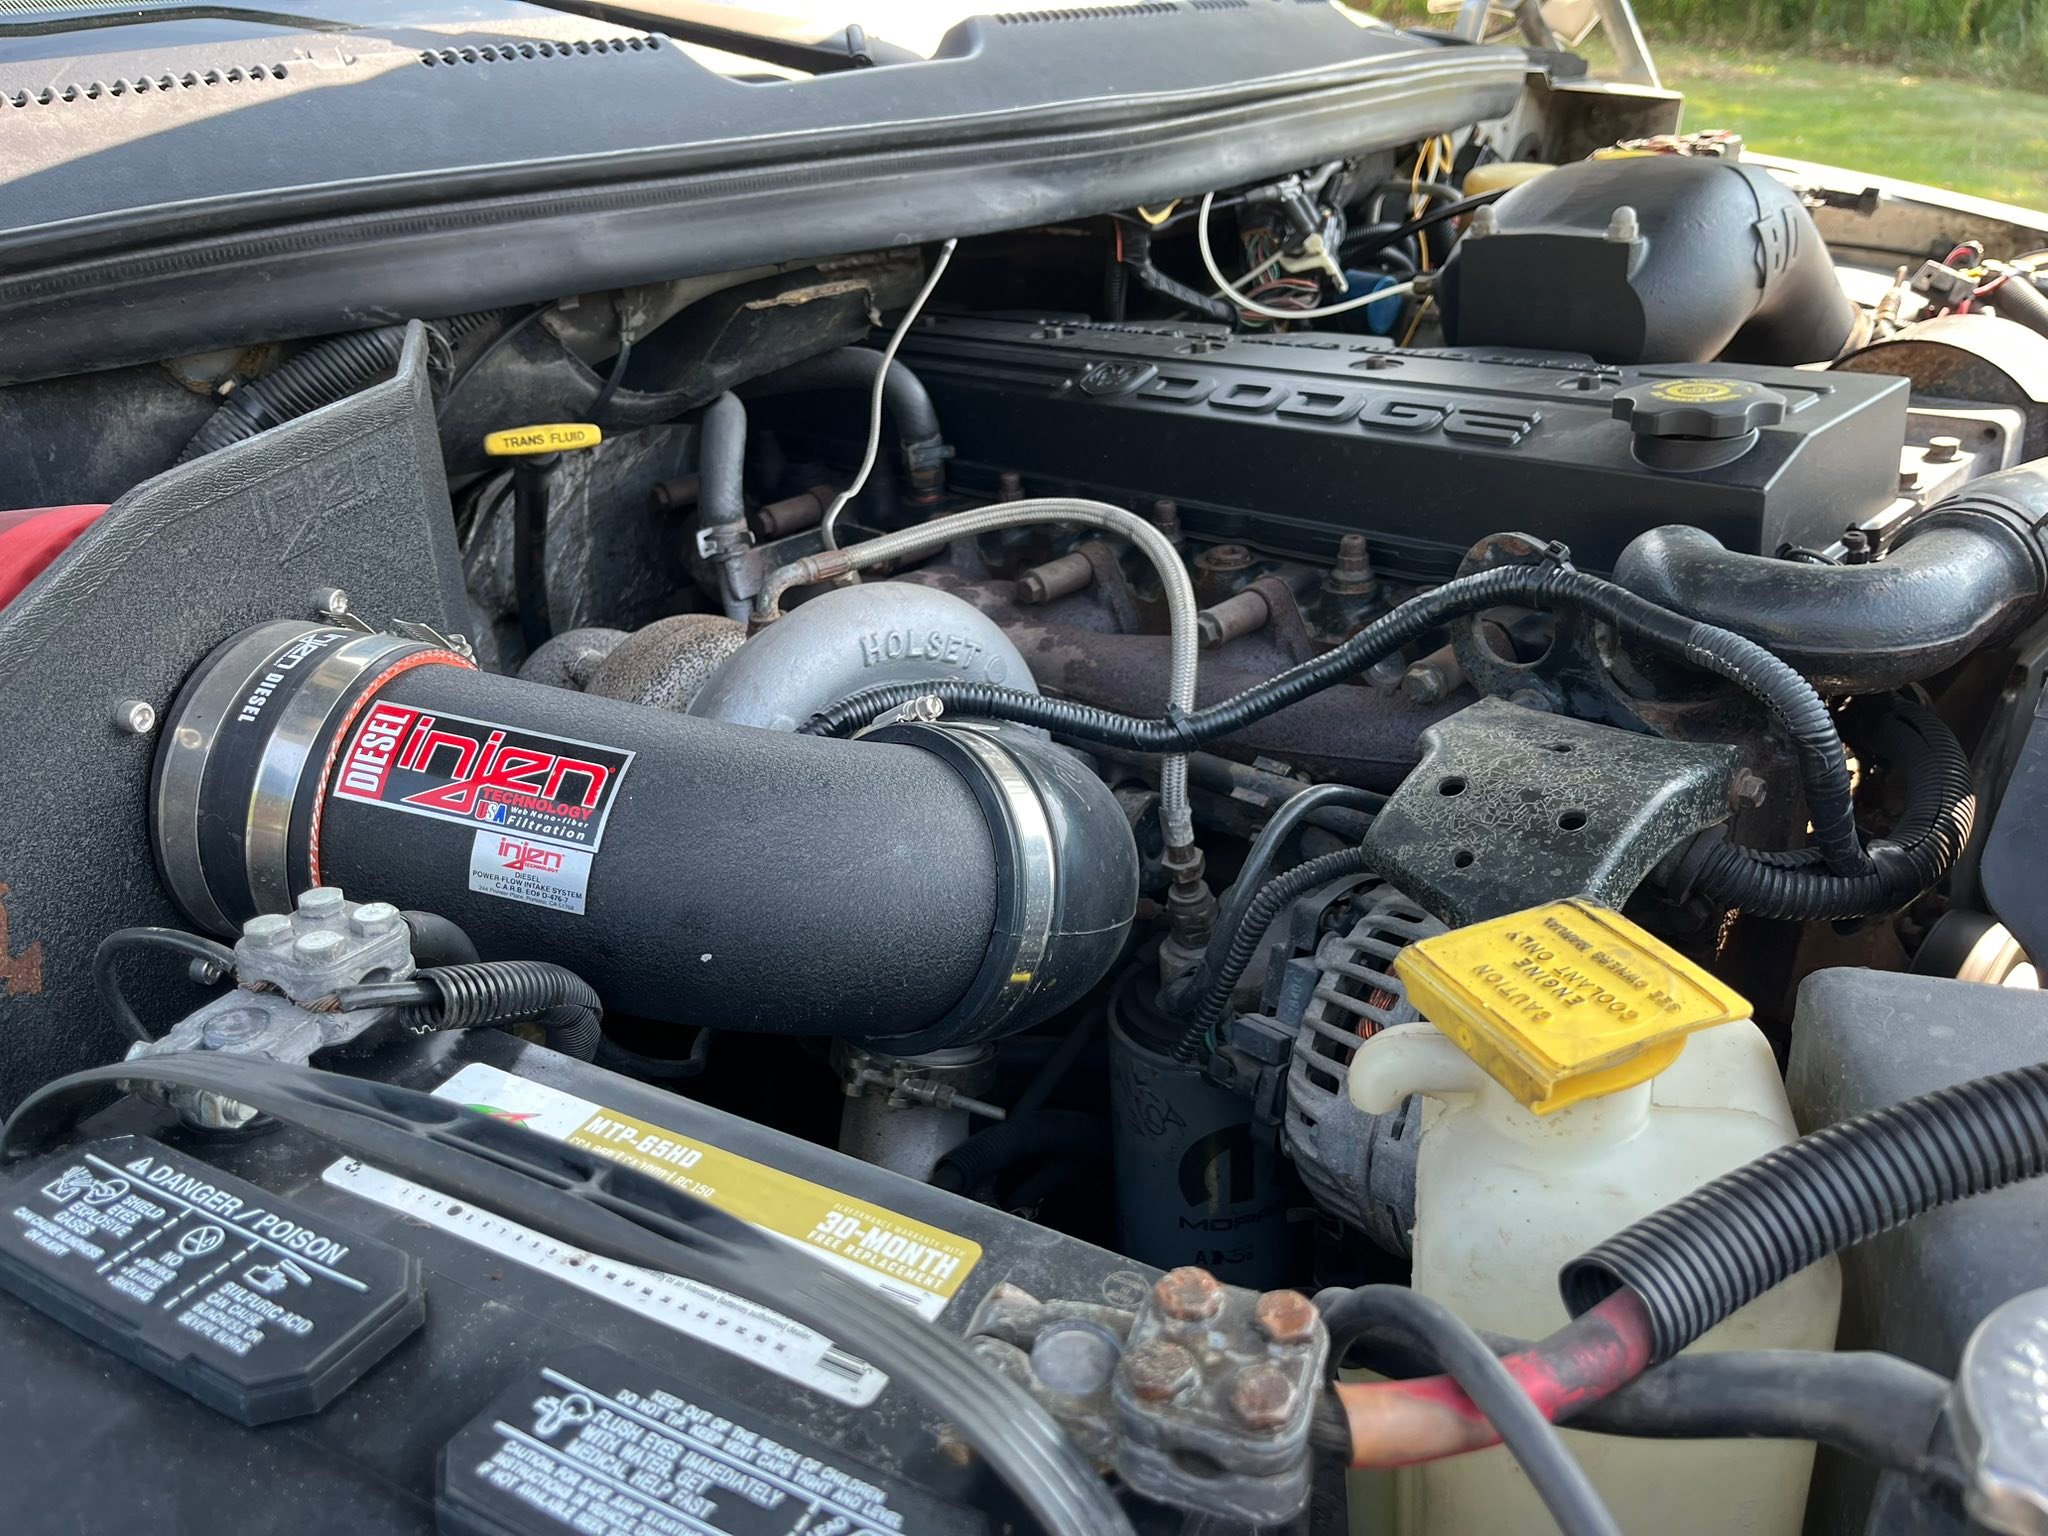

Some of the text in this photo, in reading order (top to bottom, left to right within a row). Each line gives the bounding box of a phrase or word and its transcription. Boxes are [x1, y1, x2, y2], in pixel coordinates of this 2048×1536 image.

[1137, 374, 1543, 447] DODGE
[503, 431, 585, 448] TRANS FLUID
[858, 629, 983, 669] HOLSET
[237, 672, 285, 722] DIESEL
[345, 711, 411, 793] DIESEL
[397, 716, 610, 815] injen
[475, 799, 507, 825] USA
[483, 788, 593, 820] TECHNOLOGY
[506, 815, 586, 841] Filtration
[510, 806, 589, 829] Web Nano-fiber
[498, 837, 562, 871] injen
[515, 871, 541, 883] DIESEL
[472, 869, 583, 899] POWER-FLOW INTAKE SYSTEM
[1505, 930, 1639, 1023] COOLANT ONLY
[1512, 957, 1586, 1009] ENGINE
[1543, 916, 1682, 1013] SEE OWNERS MANUAL
[1472, 962, 1552, 1023] CAUTION
[584, 1116, 703, 1169] MTP-65HD
[121, 1194, 167, 1220] SHIELD
[673, 1176, 691, 1190] RC
[690, 1182, 716, 1198] 150
[53, 1211, 97, 1236] GASES
[68, 1201, 134, 1239] EXPLOSIVE
[106, 1204, 142, 1224] EYES
[159, 1250, 186, 1268] NO
[806, 1230, 945, 1290] FREE REPLACEMENT
[816, 1210, 960, 1279] 30-MONTH
[894, 1225, 940, 1247] WARRANTY
[943, 1245, 966, 1256] WITH
[205, 1291, 266, 1328] CAN CAUSE
[218, 1281, 315, 1336] SULFURIC ACID
[683, 1280, 717, 1303] Interstate
[716, 1293, 749, 1315] Batteries
[748, 1308, 786, 1331] authorized
[579, 1423, 623, 1453] WITH
[674, 1469, 714, 1495] GET
[592, 1408, 787, 1509] FLUSH EYES IMMEDIATELY
[616, 1388, 640, 1405] DO
[636, 1398, 666, 1419] NOT
[688, 1423, 725, 1445] KEEP
[722, 1438, 758, 1462] VENT
[755, 1454, 796, 1479] CAPS
[793, 1469, 834, 1497] TIGHT
[830, 1489, 864, 1511] AND
[861, 1502, 904, 1531] LEVEL
[650, 1390, 686, 1411] KEEP
[682, 1404, 714, 1423] OUT
[730, 1425, 760, 1444] THE
[820, 1466, 888, 1504] CHILDREN
[564, 1438, 719, 1520] MEDICAL HELP FAST
